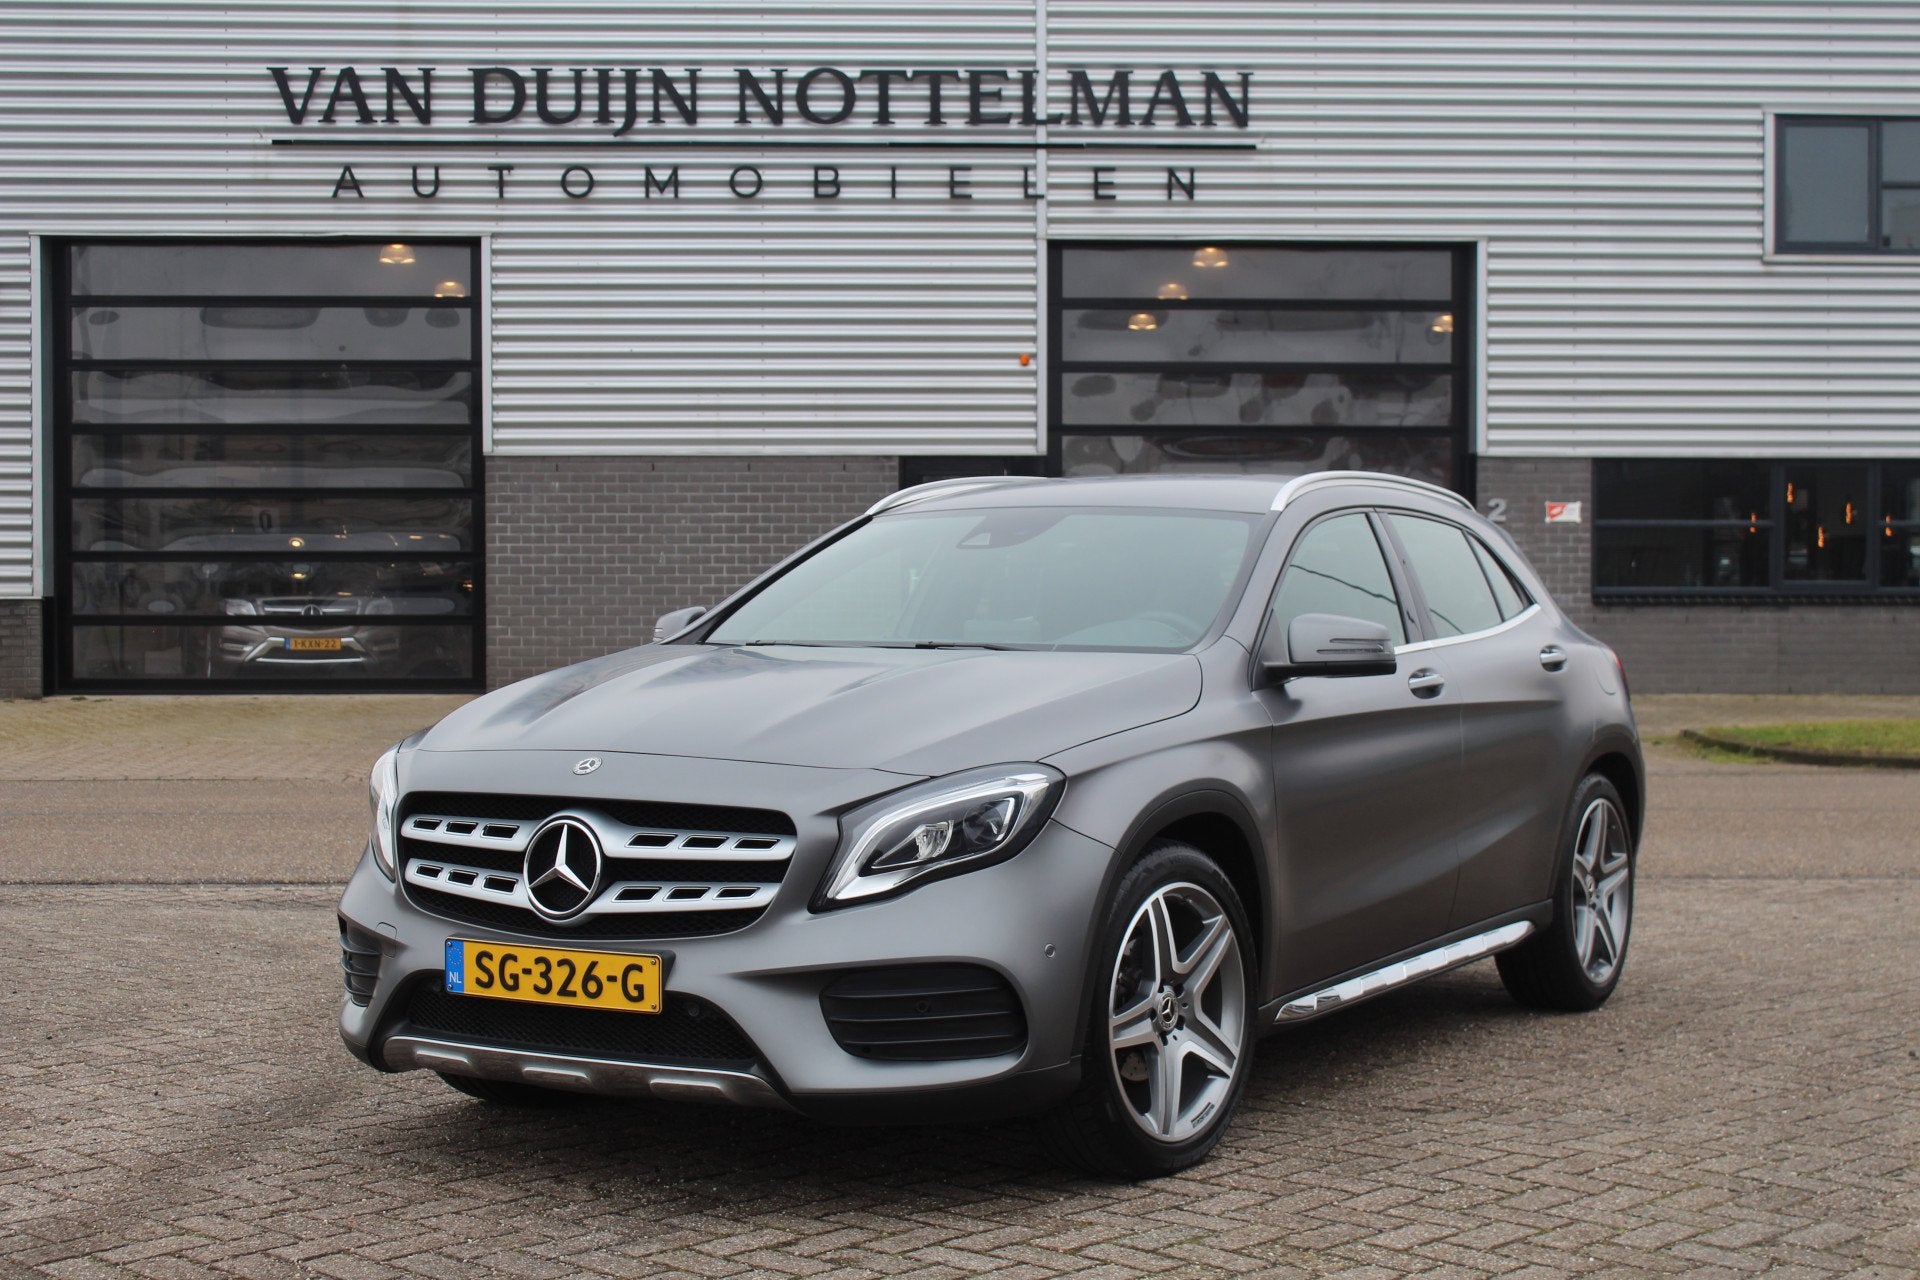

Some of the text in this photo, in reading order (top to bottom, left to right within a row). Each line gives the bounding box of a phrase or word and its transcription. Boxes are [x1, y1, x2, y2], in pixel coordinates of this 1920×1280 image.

[267, 66, 1254, 138] VAN DUIJN NOTTELMAN
[332, 165, 1195, 201] AUTOMOBIELEN
[1487, 498, 1507, 522] 2
[449, 972, 462, 984] NL
[475, 950, 645, 1003] SG-326-G
